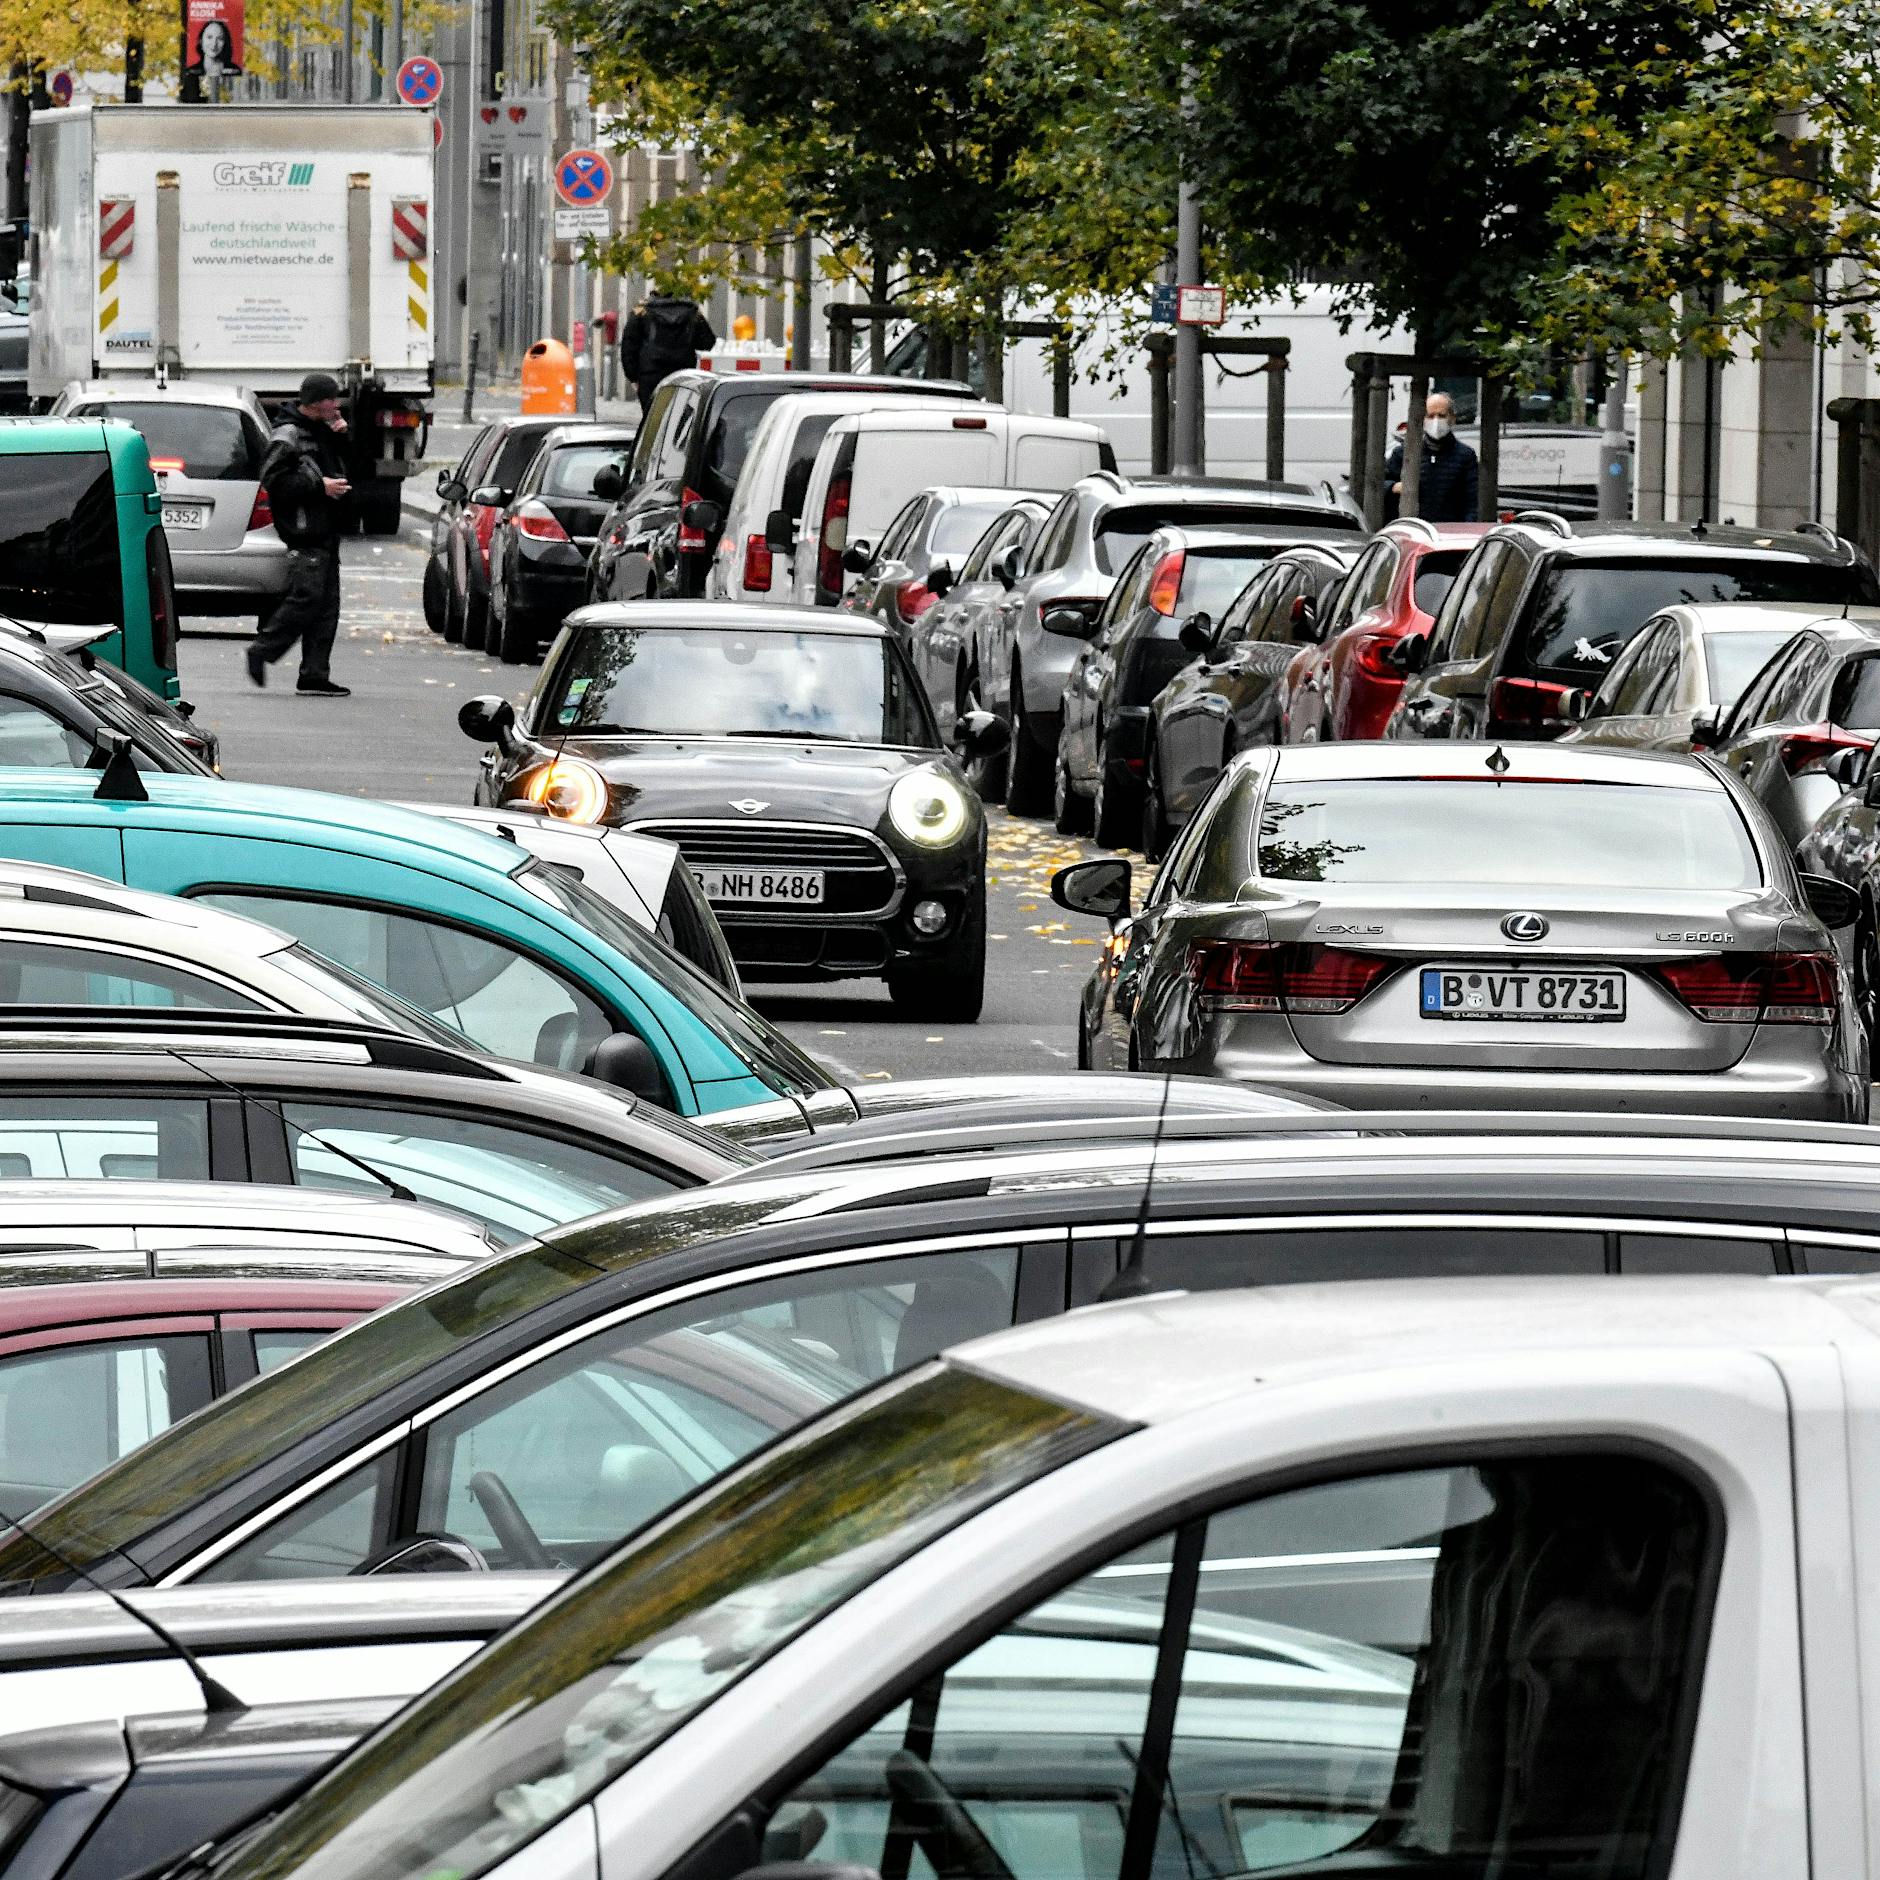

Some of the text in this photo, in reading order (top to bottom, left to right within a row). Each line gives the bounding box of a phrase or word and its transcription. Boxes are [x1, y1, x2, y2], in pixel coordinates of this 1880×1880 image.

[213, 161, 287, 186] Greif
[182, 221, 335, 232] Laufend frische Wäsche
[210, 236, 316, 249] deutschlandweit
[192, 253, 334, 265] www.mietwaesche.de
[106, 340, 152, 348] DAUTEL
[165, 510, 199, 523] 5352
[721, 874, 753, 897] NH
[760, 875, 819, 899] 8486
[1316, 923, 1383, 934] LEXUS
[1656, 931, 1735, 943] LS 600h
[1443, 976, 1619, 1010] B VT 8731
